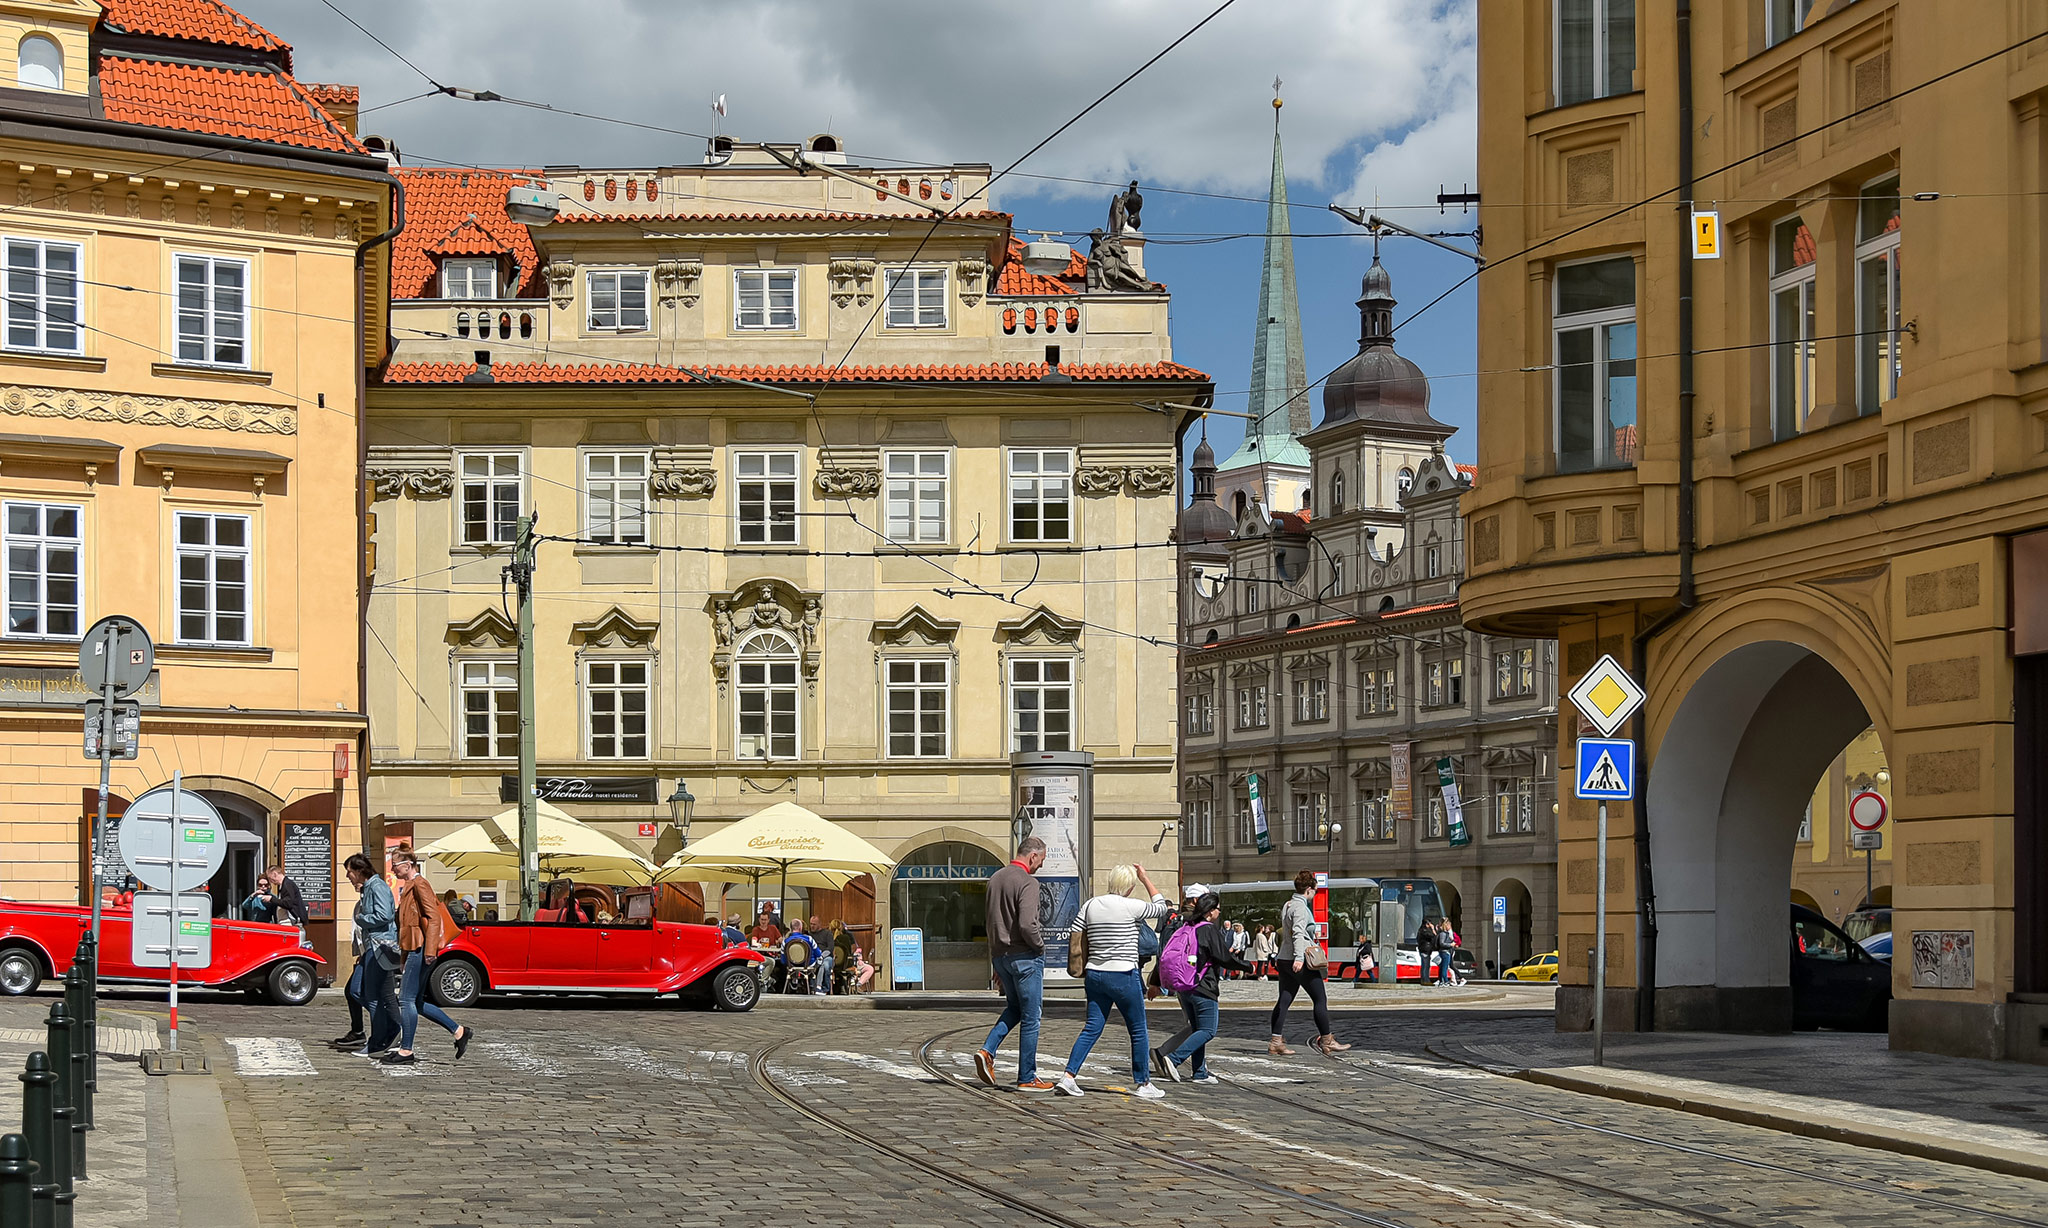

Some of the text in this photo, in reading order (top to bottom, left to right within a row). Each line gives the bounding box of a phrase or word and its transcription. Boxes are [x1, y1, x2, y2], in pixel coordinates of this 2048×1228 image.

[1702, 223, 1709, 234] r
[10, 678, 42, 693] zum
[45, 672, 94, 695] weiße
[536, 778, 594, 799] Nicholas
[747, 835, 825, 849] Budweiser
[907, 866, 988, 878] CHANGE
